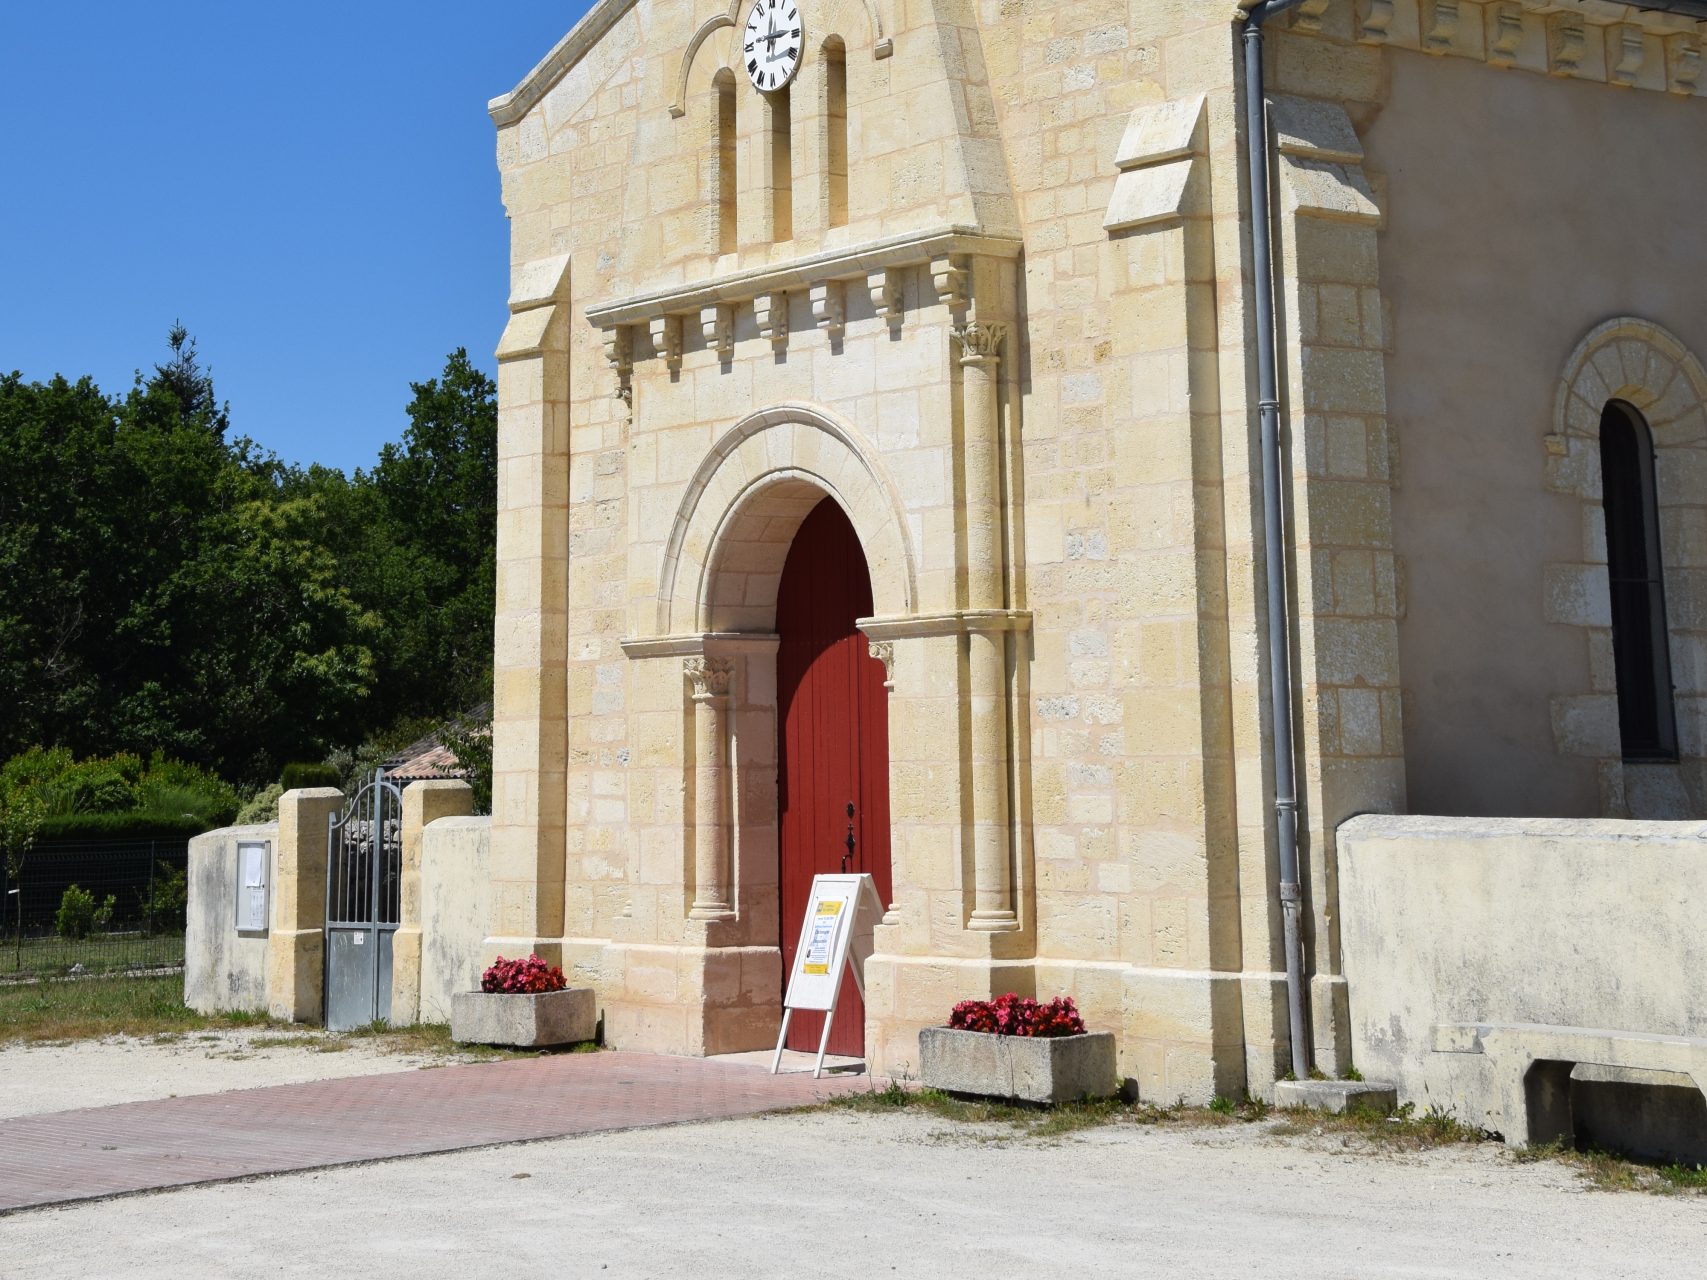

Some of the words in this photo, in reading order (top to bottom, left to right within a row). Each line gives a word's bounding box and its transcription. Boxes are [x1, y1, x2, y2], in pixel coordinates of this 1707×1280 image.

[756, 3, 765, 19] XI
[788, 8, 797, 21] II
[748, 23, 757, 32] X
[791, 28, 800, 39] III
[745, 42, 754, 53] IX
